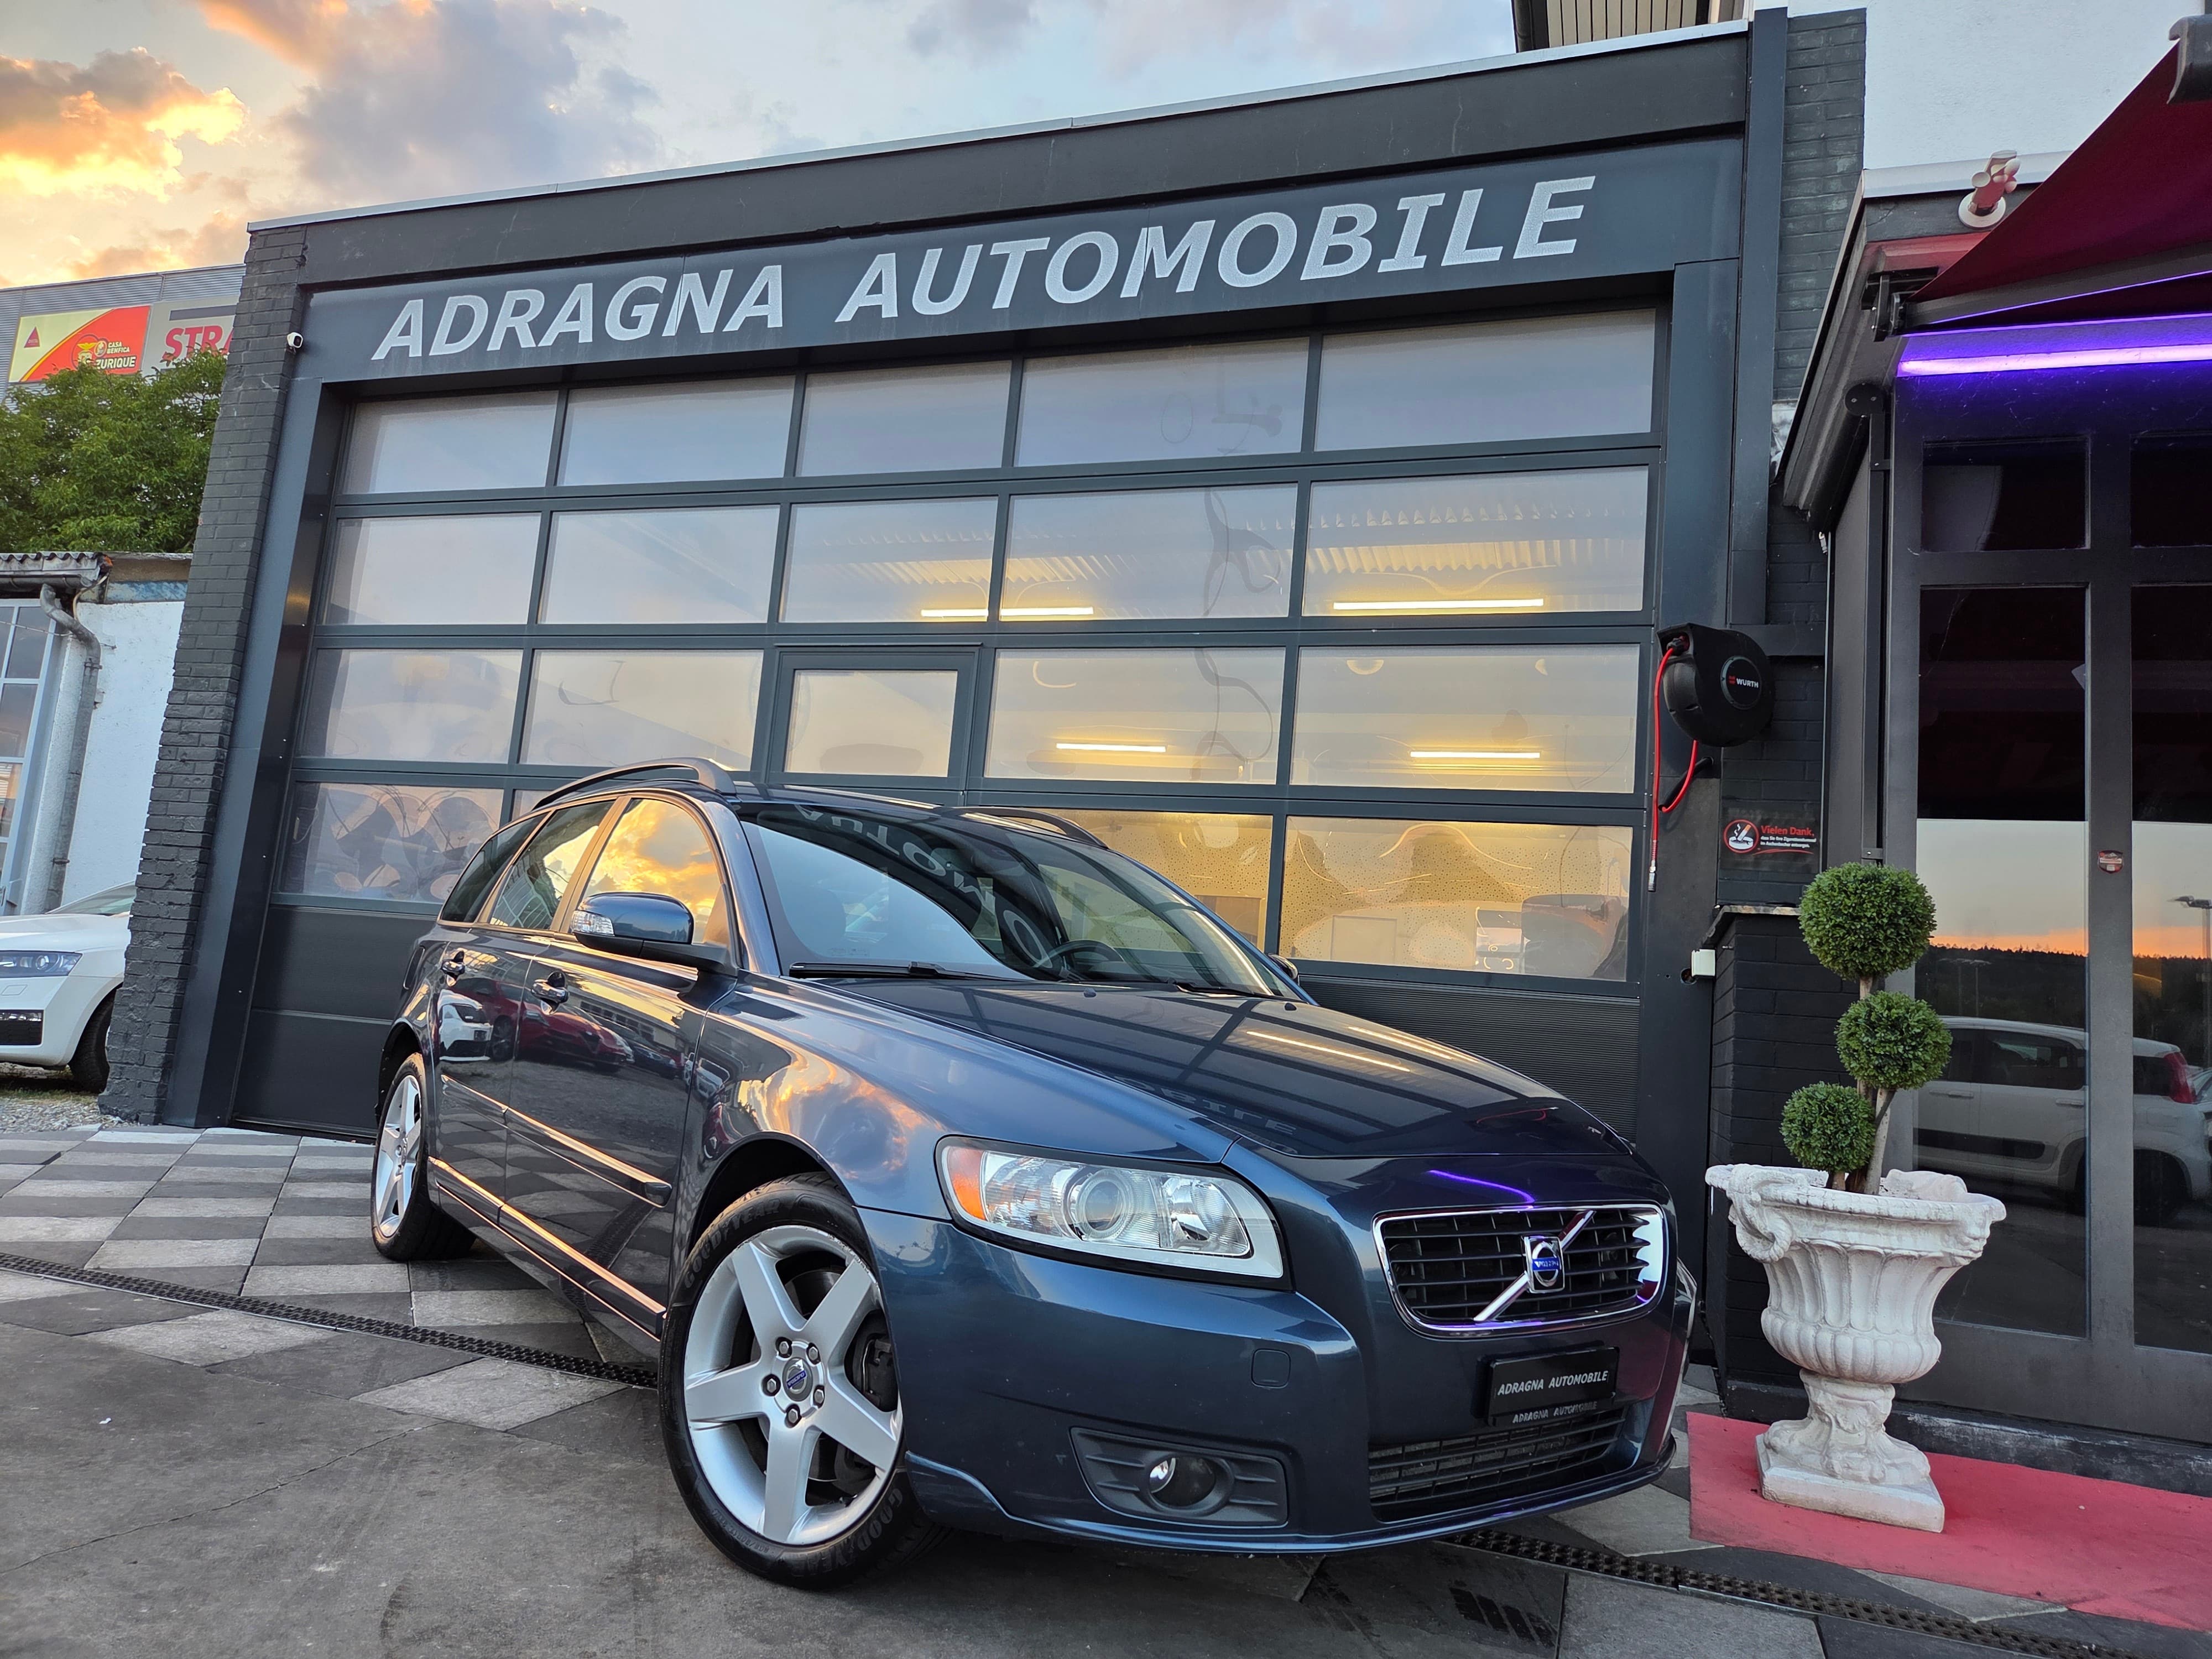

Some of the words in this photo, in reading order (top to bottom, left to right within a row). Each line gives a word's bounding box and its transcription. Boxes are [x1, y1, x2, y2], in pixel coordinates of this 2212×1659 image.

[371, 264, 782, 361] ADRAGNA
[834, 175, 1596, 322] AUTOMOBILE
[161, 325, 234, 361] STR
[96, 356, 136, 369] ZURIQUE
[1761, 826, 1788, 834] Vielen
[1498, 1379, 1544, 1396] ADRAGNA
[1548, 1370, 1609, 1389] AUTOMOBILE
[1512, 1409, 1548, 1423] ADRAGNA
